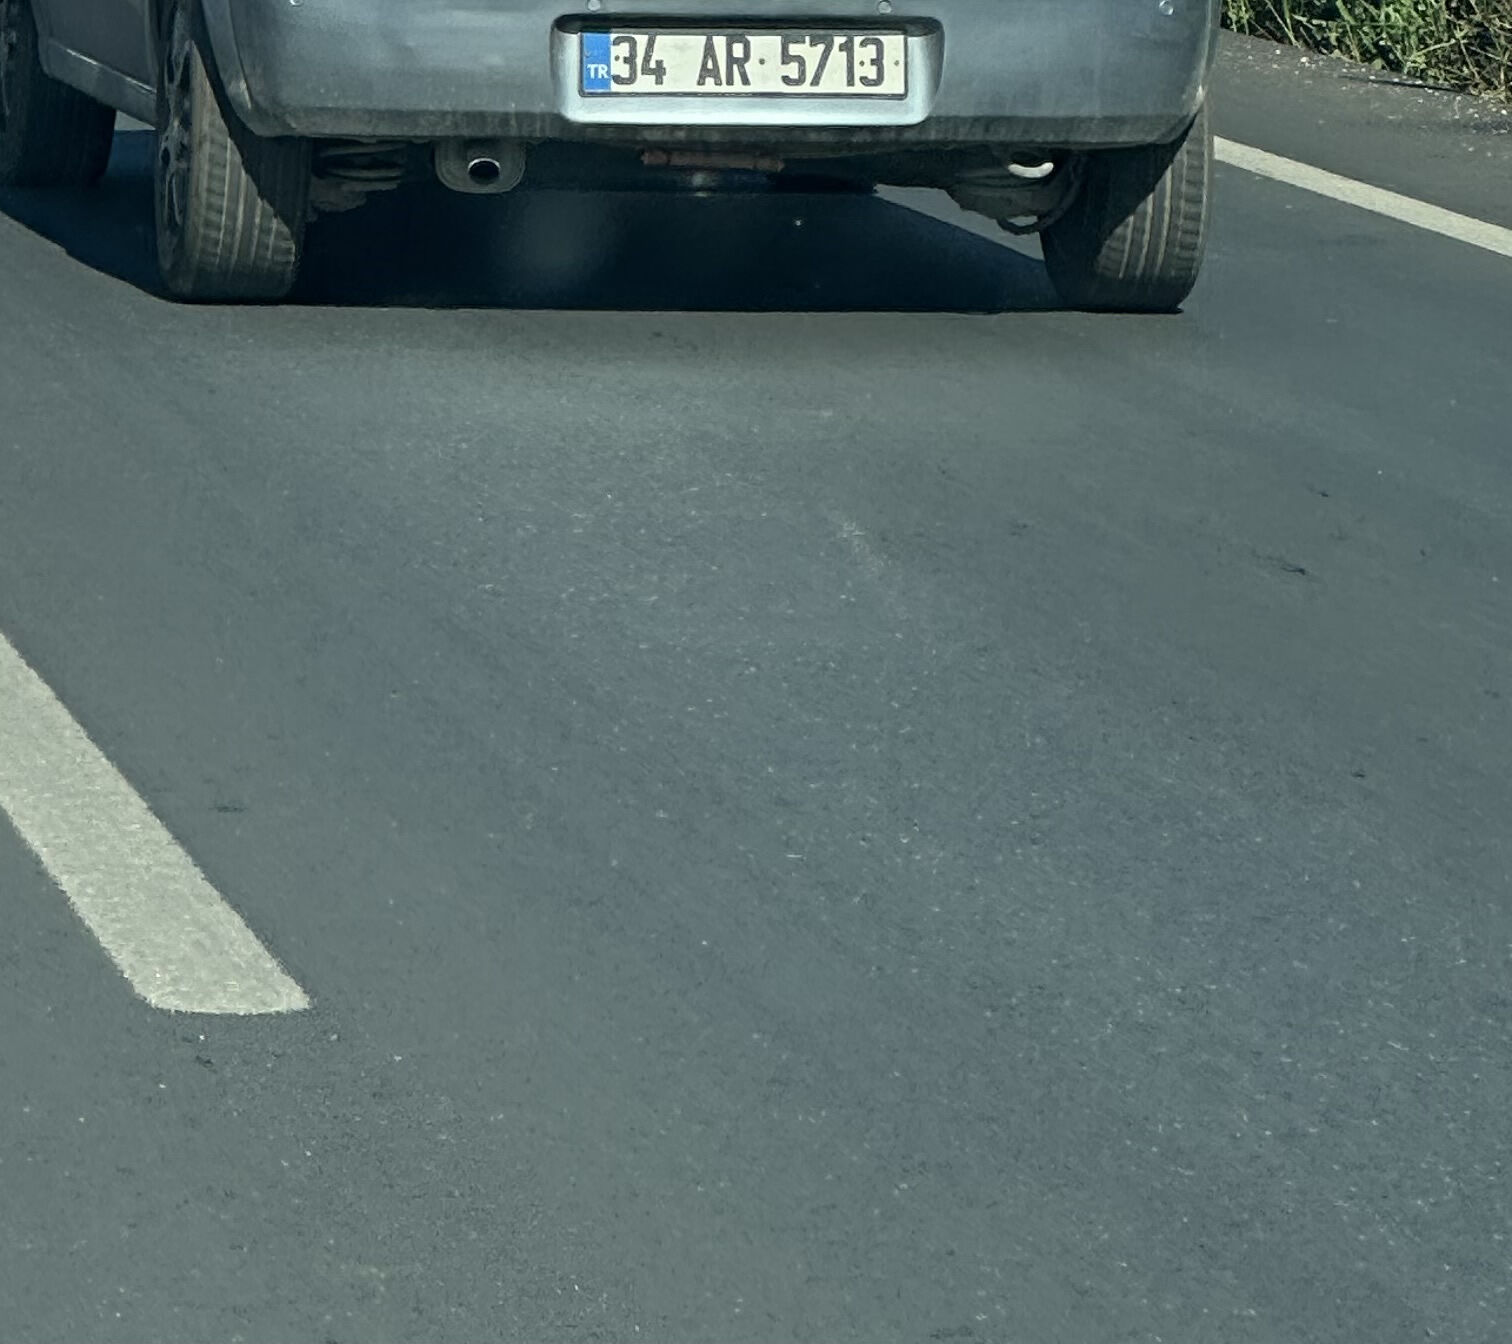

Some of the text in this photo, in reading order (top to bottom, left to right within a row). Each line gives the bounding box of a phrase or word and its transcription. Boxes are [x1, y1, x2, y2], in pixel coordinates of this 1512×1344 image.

[587, 64, 609, 80] TR
[612, 34, 885, 87] 34 AR 5713
